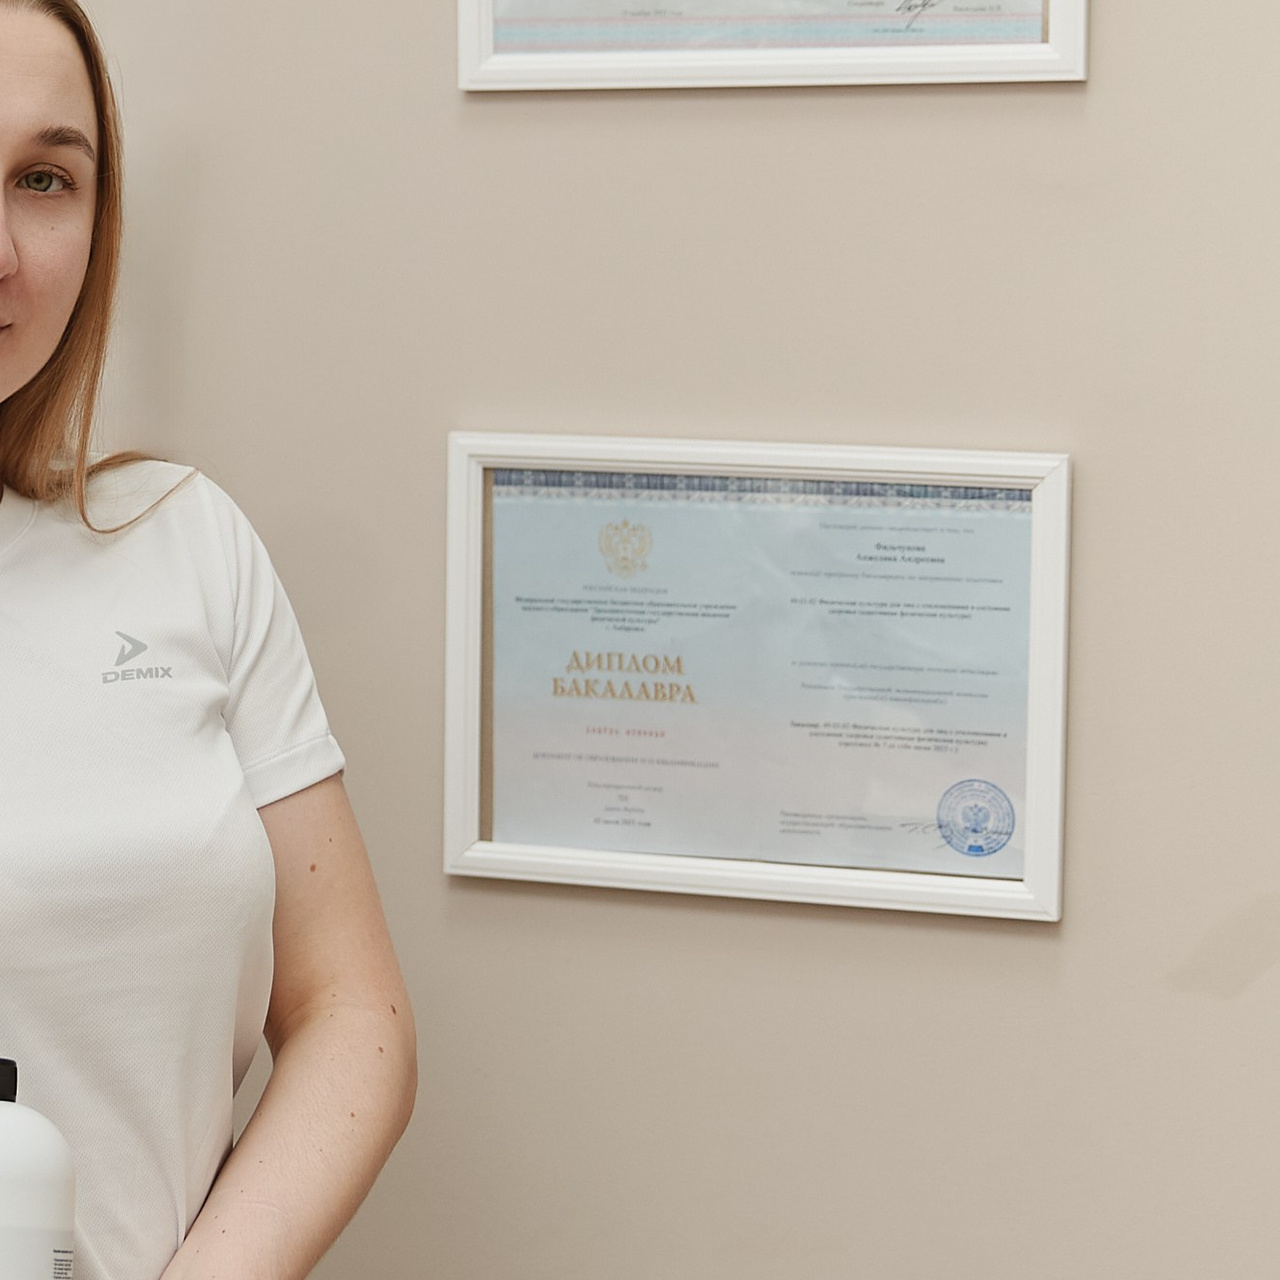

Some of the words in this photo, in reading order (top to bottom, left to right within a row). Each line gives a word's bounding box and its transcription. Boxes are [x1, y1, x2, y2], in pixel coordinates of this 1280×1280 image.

[101, 666, 173, 684] DEMIX
[566, 649, 685, 676] ДИПЛОМ
[552, 677, 698, 705] БАКАЛАВРА
